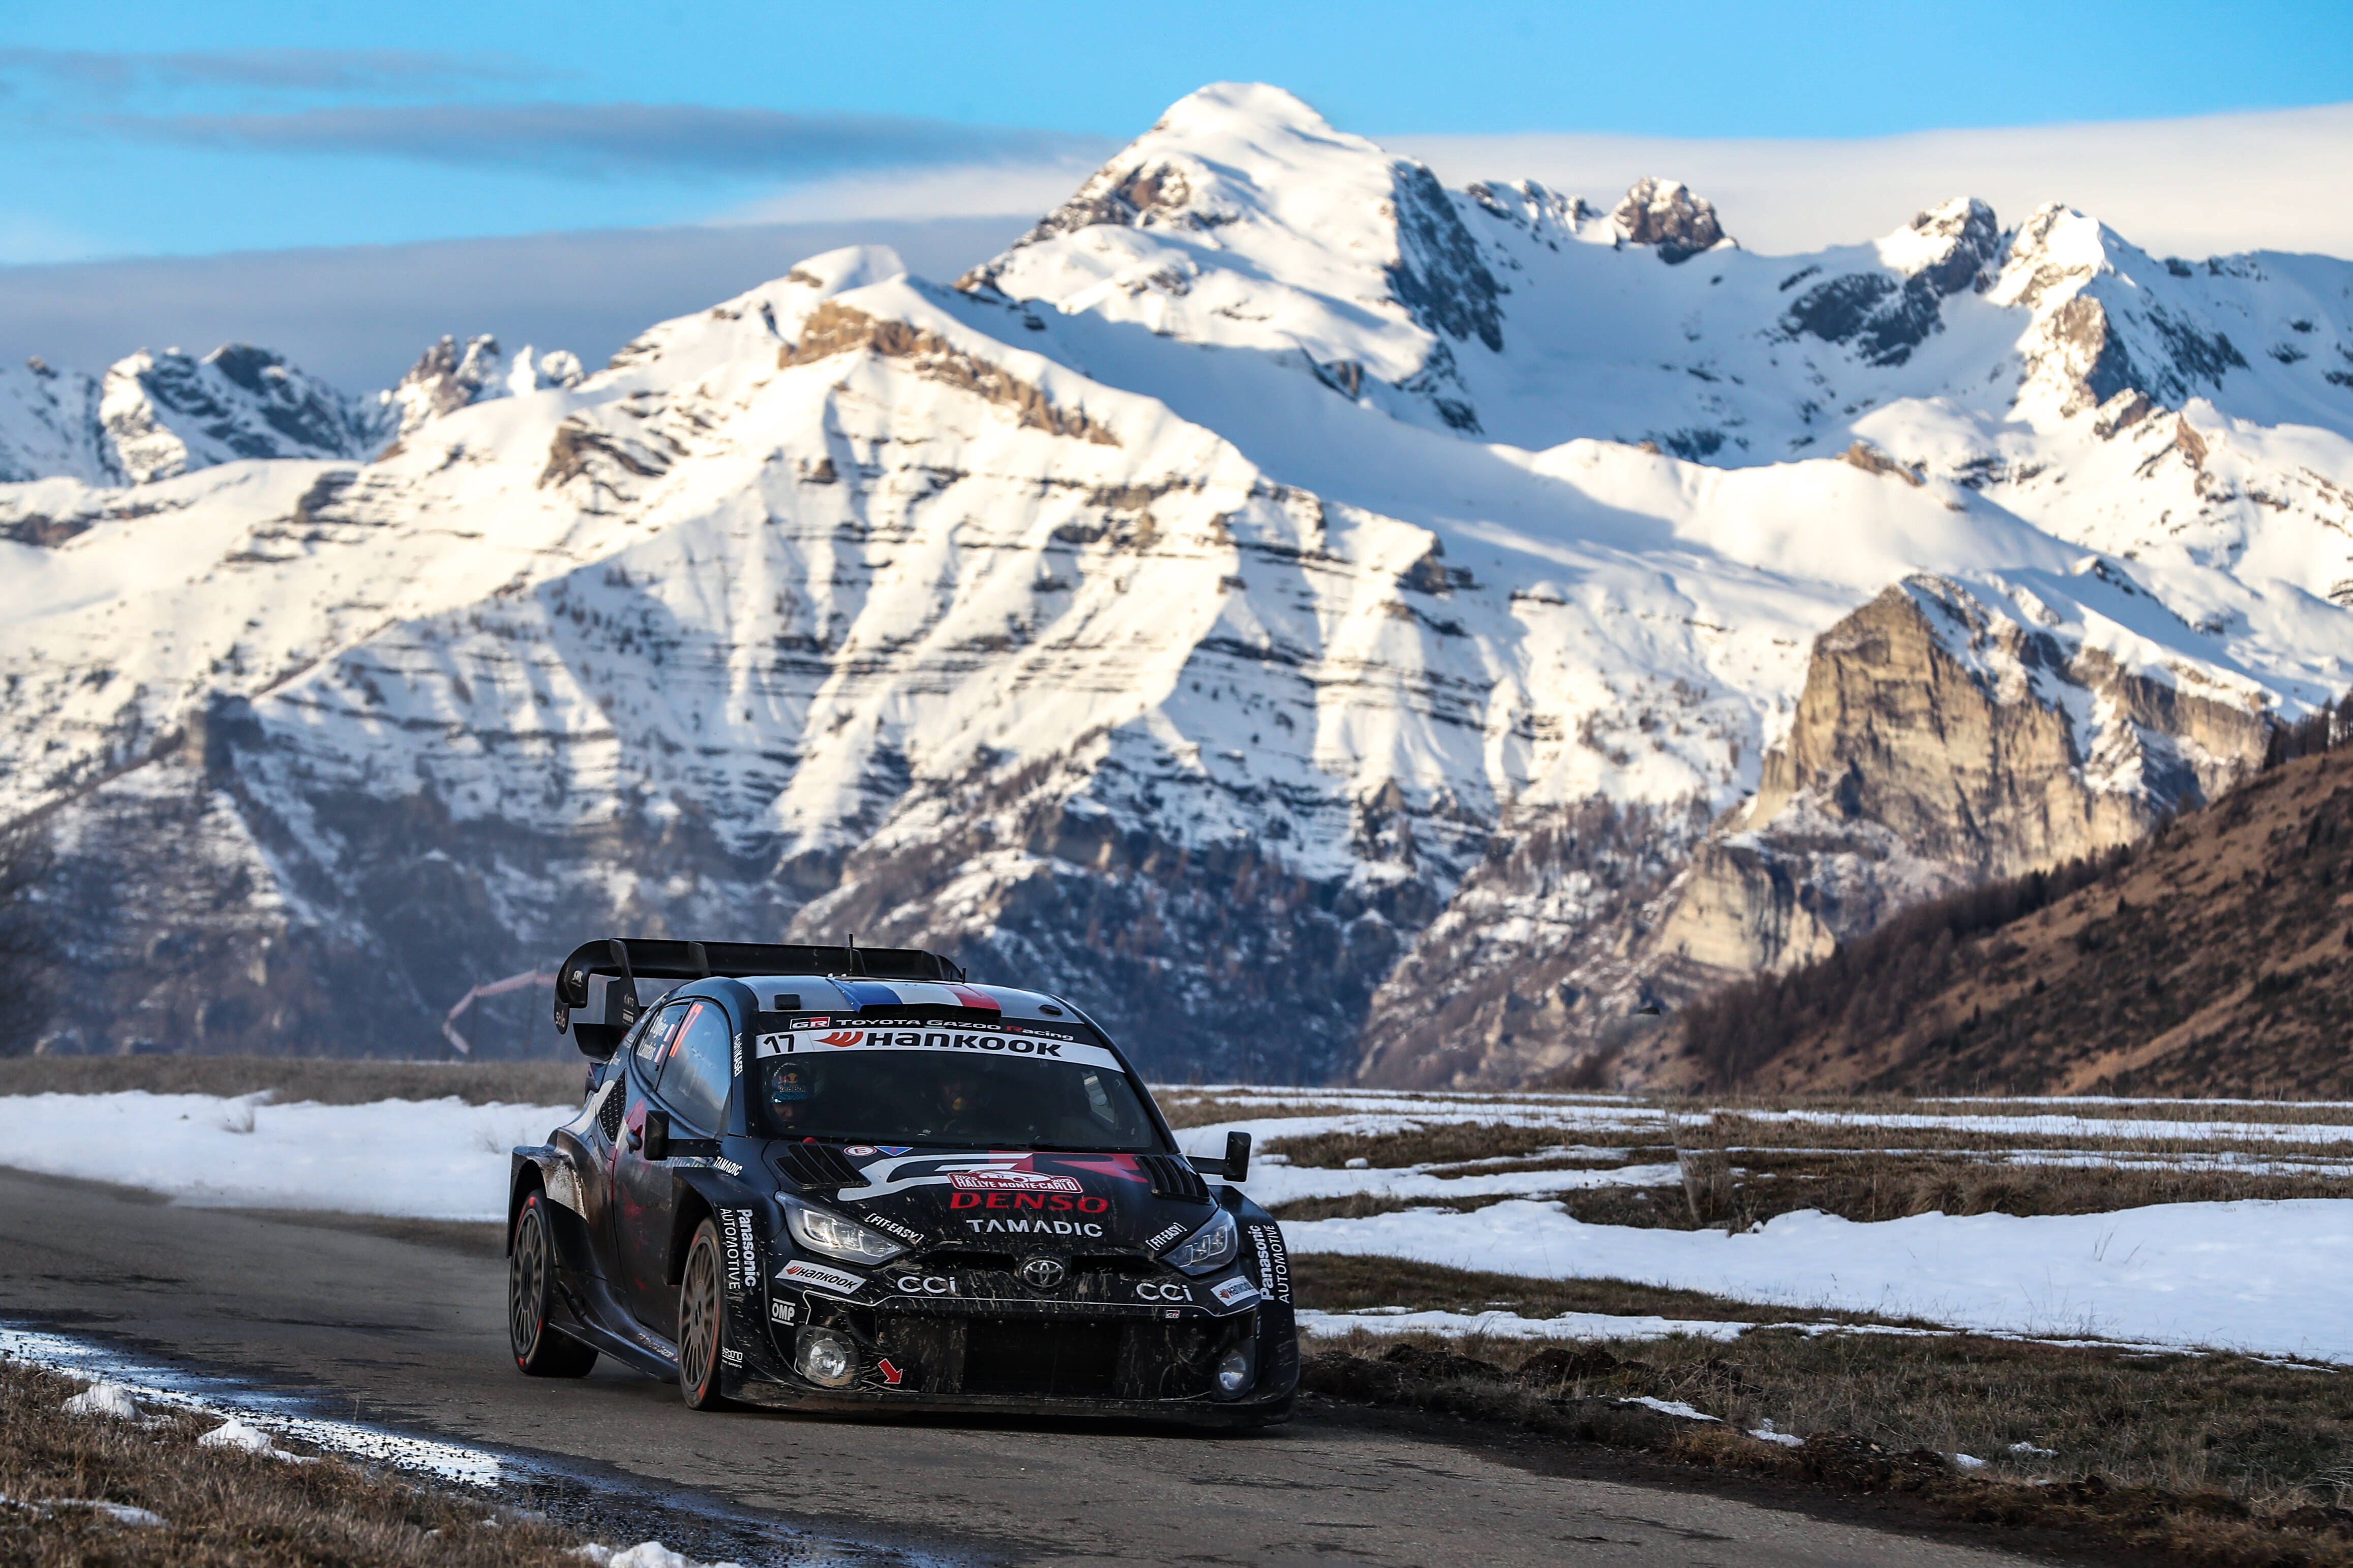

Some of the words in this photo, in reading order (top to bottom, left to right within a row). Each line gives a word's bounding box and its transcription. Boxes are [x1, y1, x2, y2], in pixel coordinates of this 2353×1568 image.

[669, 1003, 704, 1058] 17
[792, 1020, 828, 1028] GR
[926, 1020, 1002, 1030] GAZOO
[1006, 1026, 1074, 1041] Racing
[763, 1034, 795, 1054] 17
[713, 1156, 743, 1176] TAMADIC
[954, 1177, 997, 1187] RALLYE
[998, 1181, 1078, 1191] MONTE-CARLO
[950, 1192, 1108, 1213] DENSO
[966, 1219, 1103, 1237] TAMADIC
[720, 1208, 741, 1289] AUTOMOTIVE
[736, 1209, 757, 1287] Panasonic
[1248, 1225, 1275, 1300] Panasonic
[1263, 1224, 1290, 1304] AUTOMOTIVE
[772, 1302, 795, 1321] OMP
